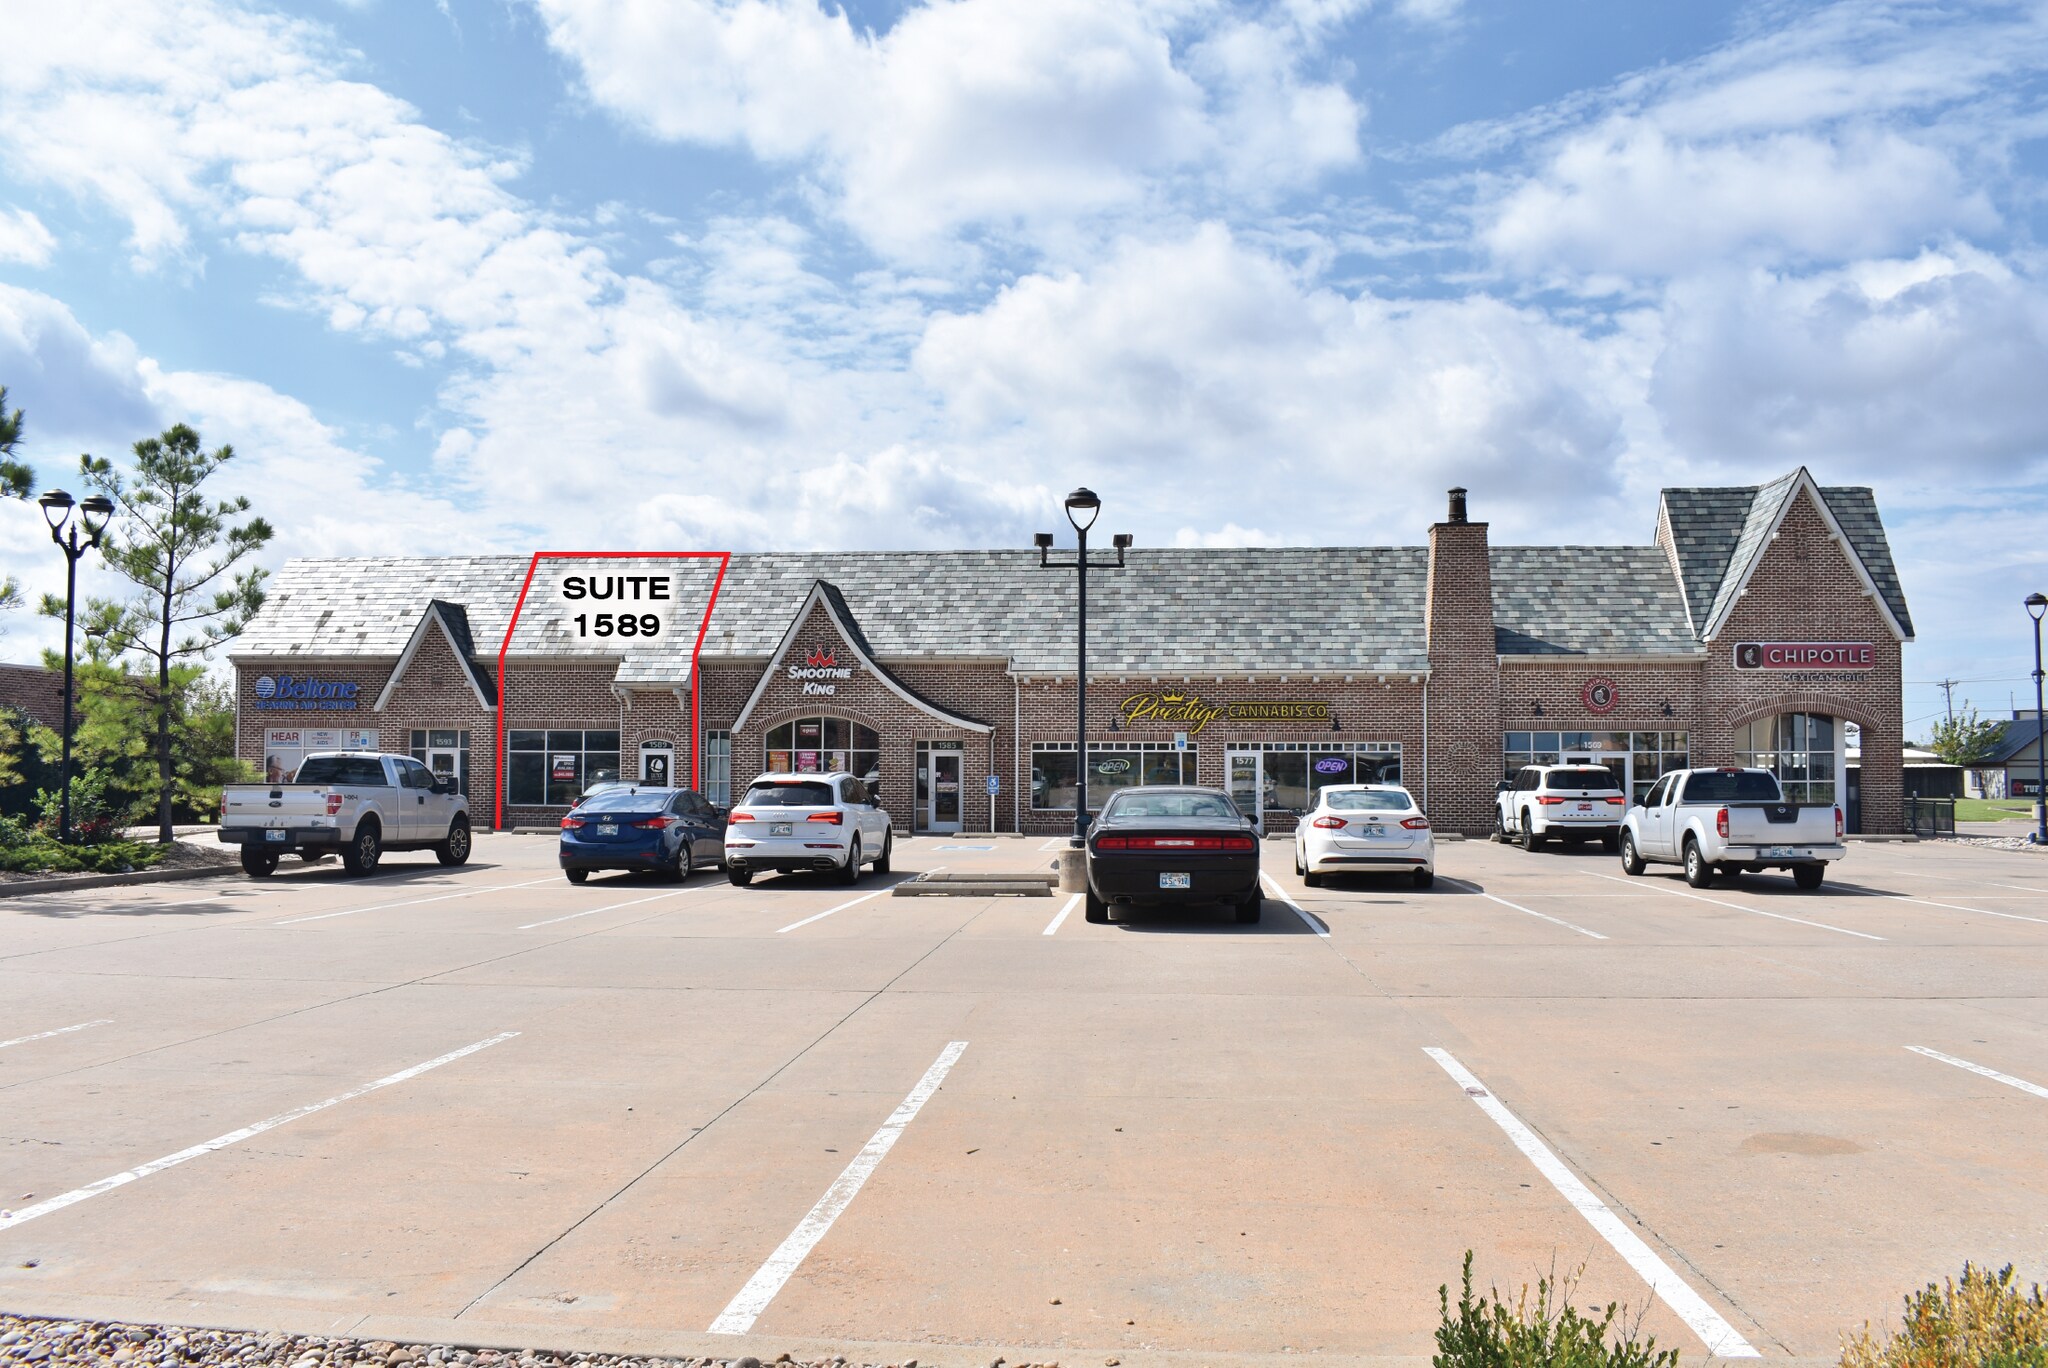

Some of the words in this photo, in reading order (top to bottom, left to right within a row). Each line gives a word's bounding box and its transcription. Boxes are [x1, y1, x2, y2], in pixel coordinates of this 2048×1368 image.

[1769, 649, 1871, 663] CHIPOTLE
[788, 665, 852, 680] SMOOTHIE
[275, 675, 357, 699] Beltone
[1585, 678, 1617, 693] CHIPOTLE
[255, 701, 297, 710] HEARING
[300, 701, 317, 710] AID
[320, 701, 357, 710] CENTER
[1121, 693, 1225, 735] Prestige
[1228, 705, 1302, 717] CANNABIS
[271, 732, 299, 741] HEAR
[1101, 762, 1126, 771] OPEN
[1235, 757, 1254, 765] 1577
[1317, 760, 1344, 771] OPEN
